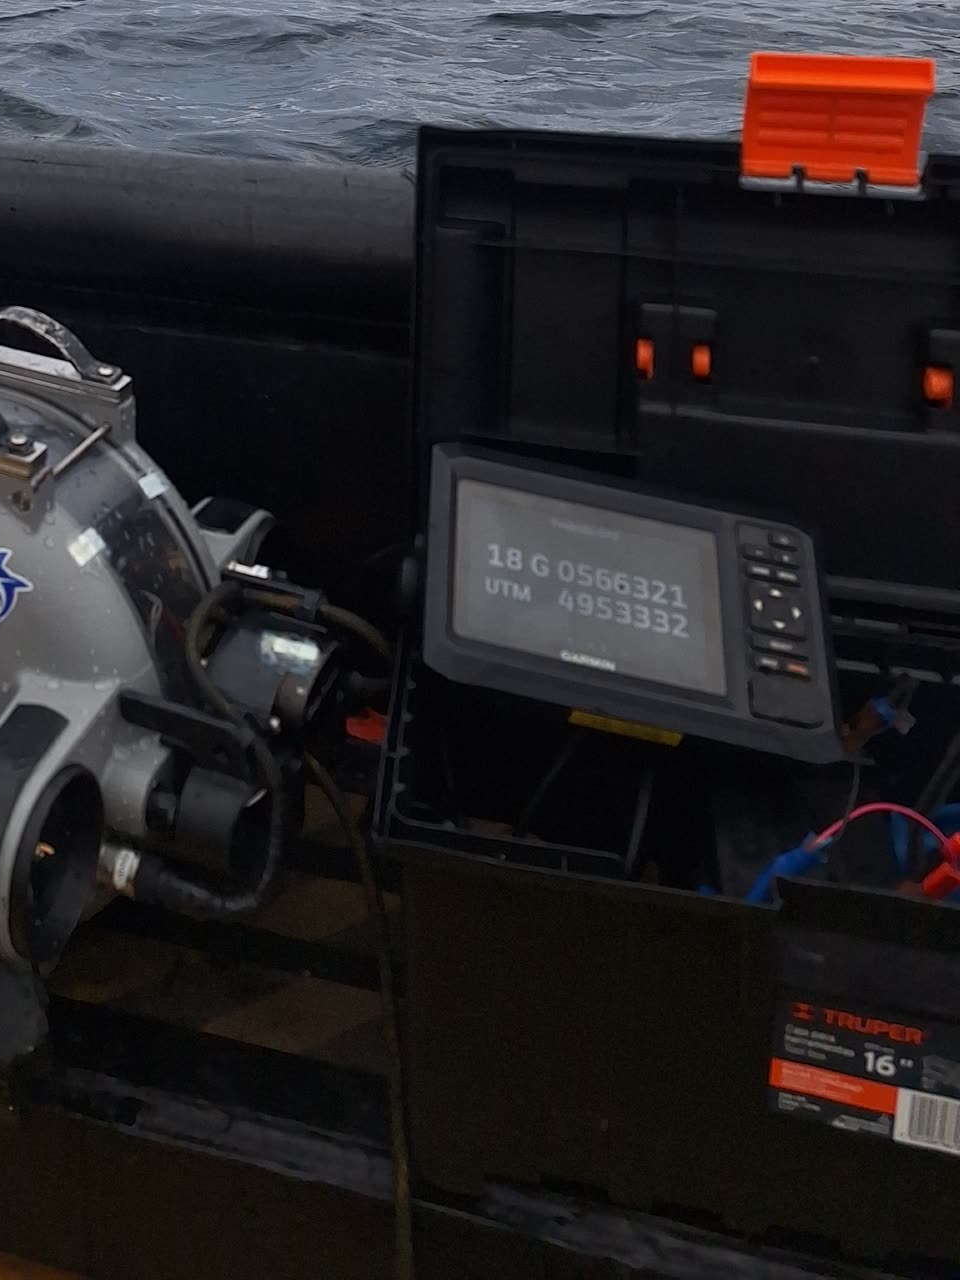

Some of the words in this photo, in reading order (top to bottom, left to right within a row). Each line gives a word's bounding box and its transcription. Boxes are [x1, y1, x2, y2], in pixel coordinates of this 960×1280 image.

[484, 575, 532, 602] UTM
[558, 588, 689, 638] 4953332
[487, 543, 523, 570] 18
[530, 553, 550, 577] G
[557, 560, 688, 608] 0566321
[823, 1007, 925, 1048] TRUPER
